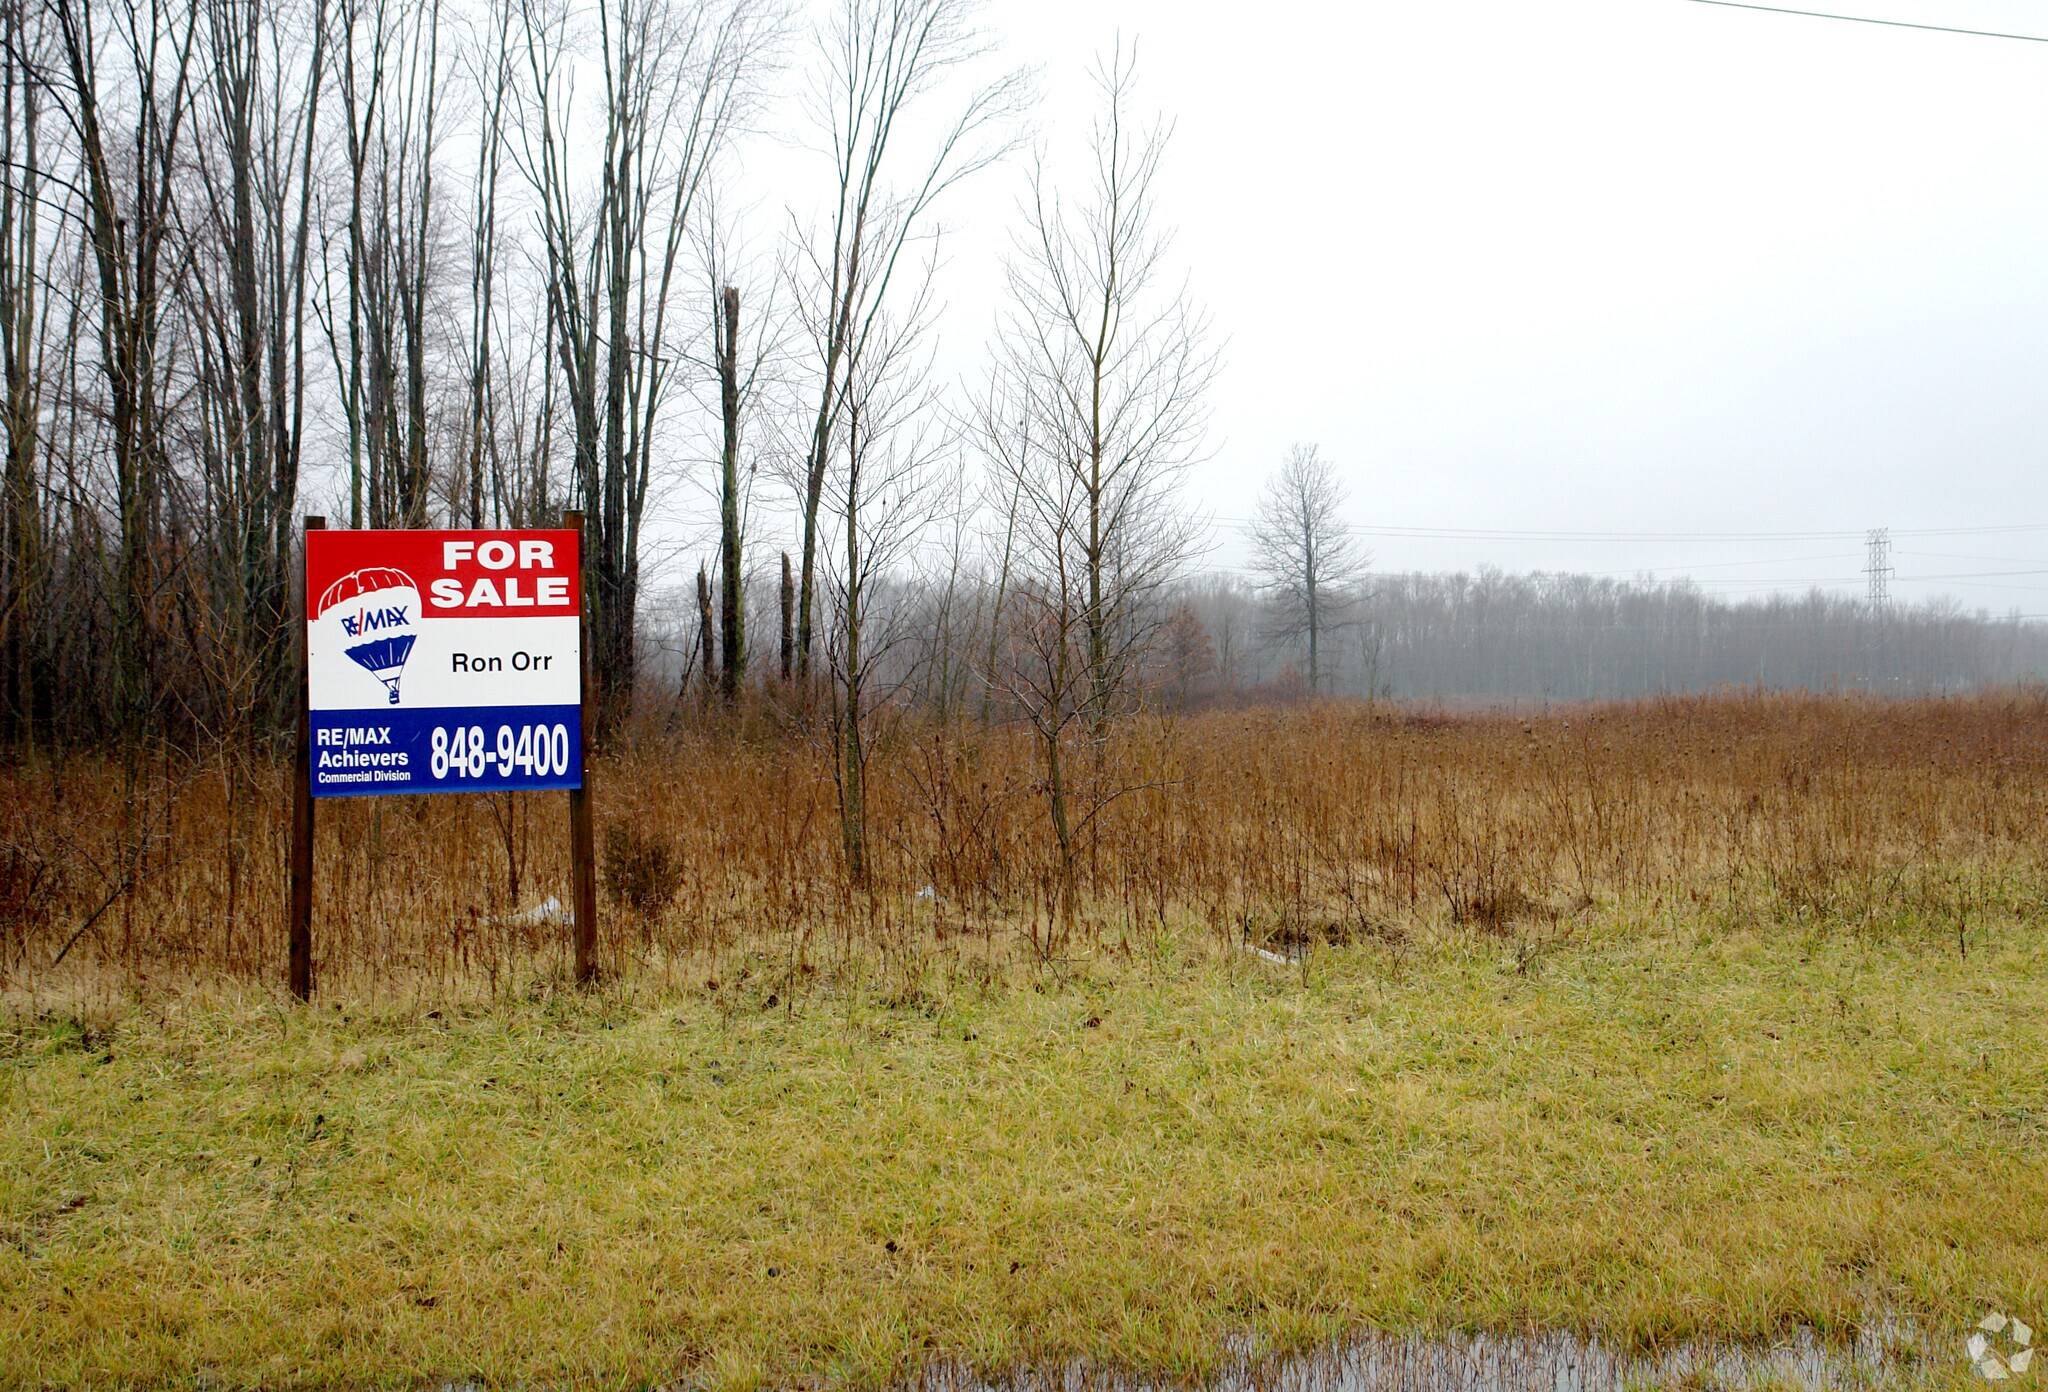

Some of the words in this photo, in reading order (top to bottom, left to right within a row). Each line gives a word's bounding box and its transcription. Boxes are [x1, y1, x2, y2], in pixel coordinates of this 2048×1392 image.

[443, 540, 554, 570] FOR
[430, 577, 570, 608] SALE
[341, 605, 410, 637] RE/MAX
[452, 653, 502, 673] Ron
[511, 651, 553, 671] Orr
[317, 727, 391, 749] RE/MAX
[430, 723, 569, 779] 848-9400
[318, 750, 409, 768] Achievers
[318, 771, 372, 784] Commercial
[374, 770, 411, 782] Division
